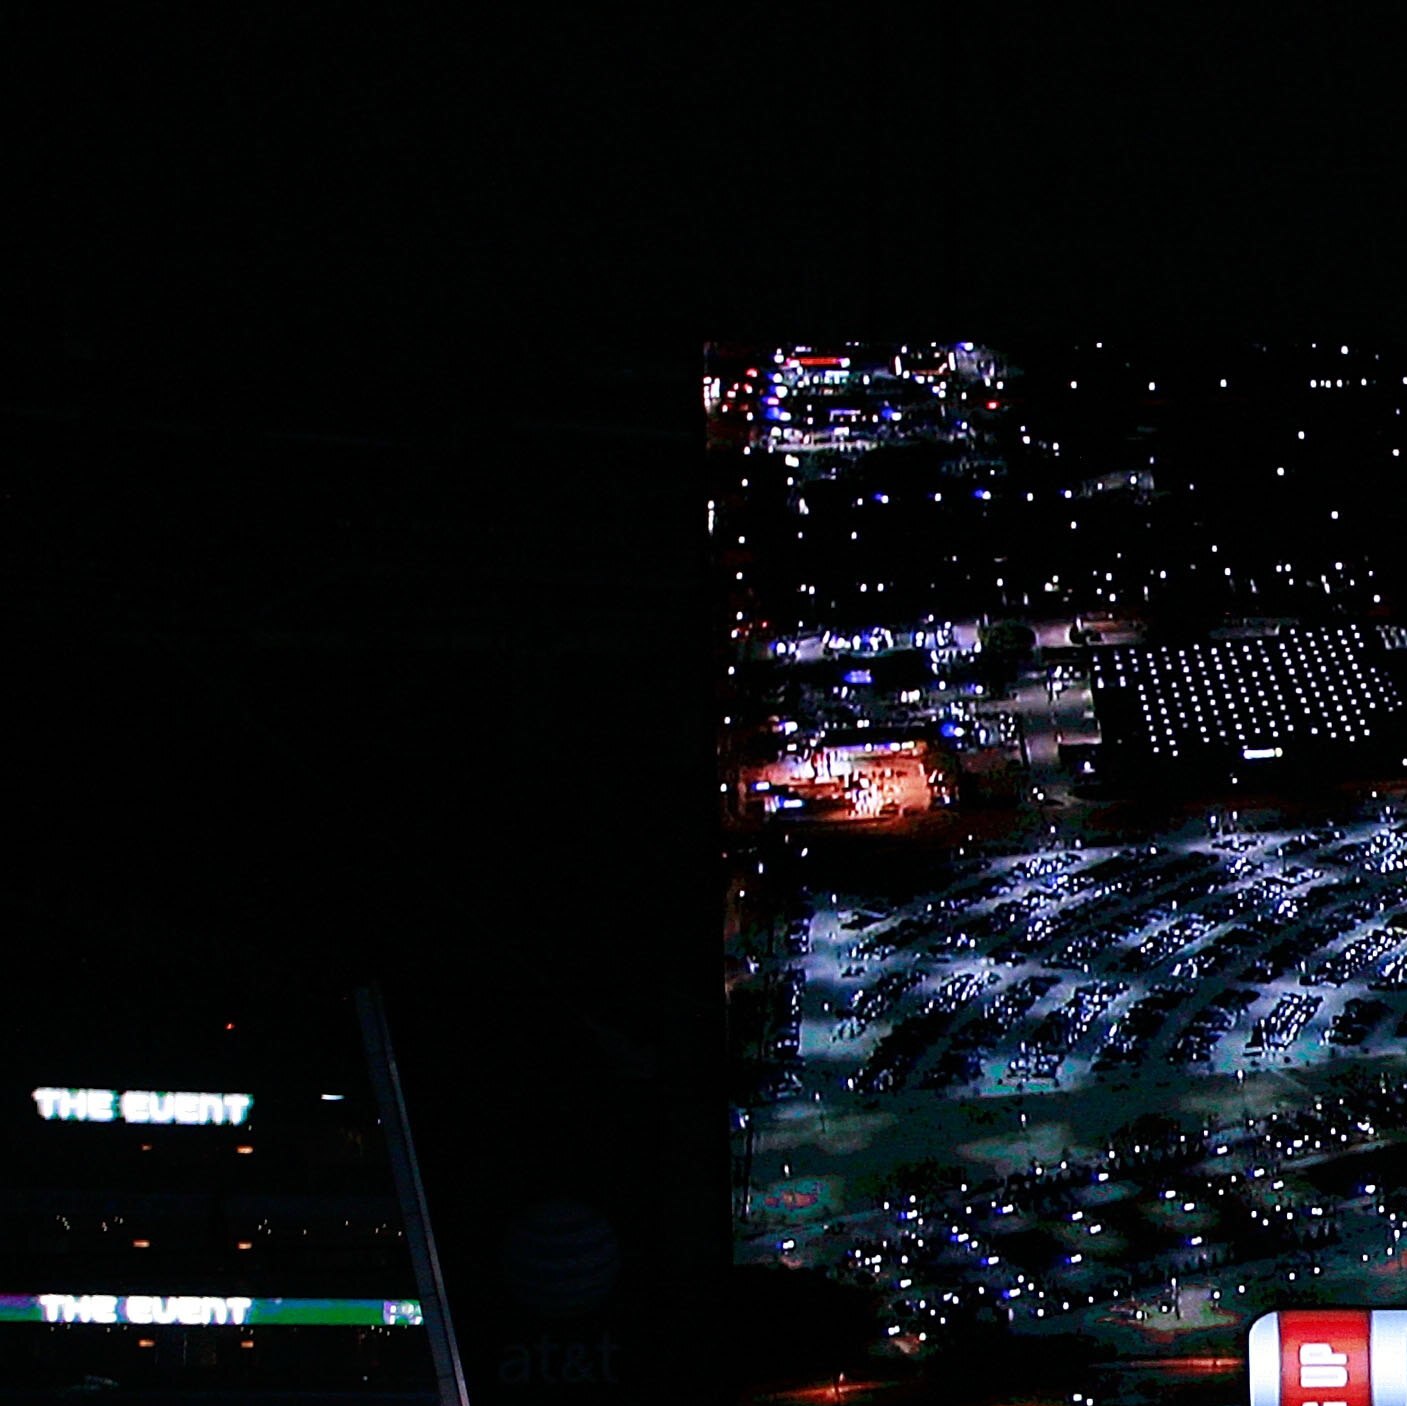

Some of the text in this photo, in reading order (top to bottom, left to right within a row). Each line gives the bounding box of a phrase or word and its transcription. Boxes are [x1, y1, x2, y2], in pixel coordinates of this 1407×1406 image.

[33, 1087, 116, 1122] THE
[39, 1294, 118, 1323] THE
[1299, 1343, 1347, 1388] UP
